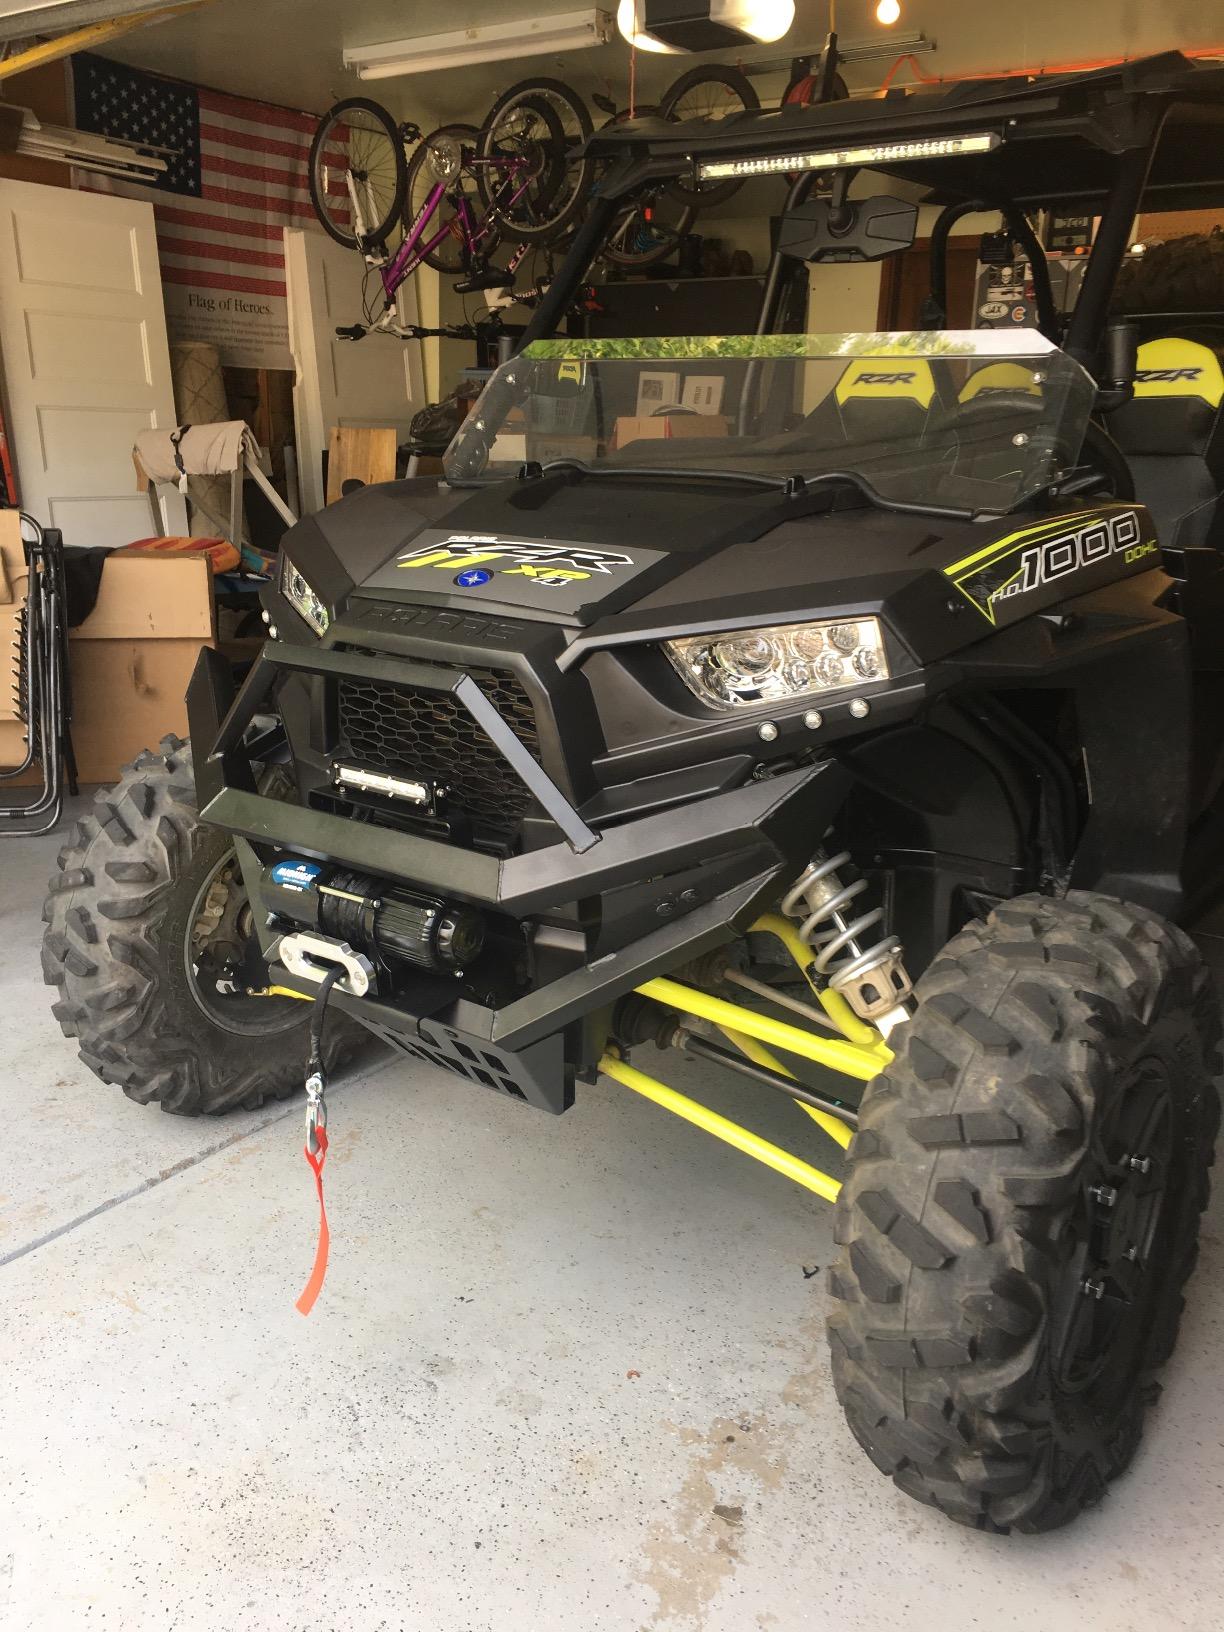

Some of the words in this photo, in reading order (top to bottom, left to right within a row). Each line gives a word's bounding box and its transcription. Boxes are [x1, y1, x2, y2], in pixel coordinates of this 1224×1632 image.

[188, 293, 215, 312] Flag
[218, 297, 233, 311] of
[852, 372, 916, 386] RZR
[1021, 510, 1141, 593] 1000
[1124, 539, 1158, 564] DOHC
[499, 564, 593, 580] XP
[357, 605, 526, 640] POLARIS
